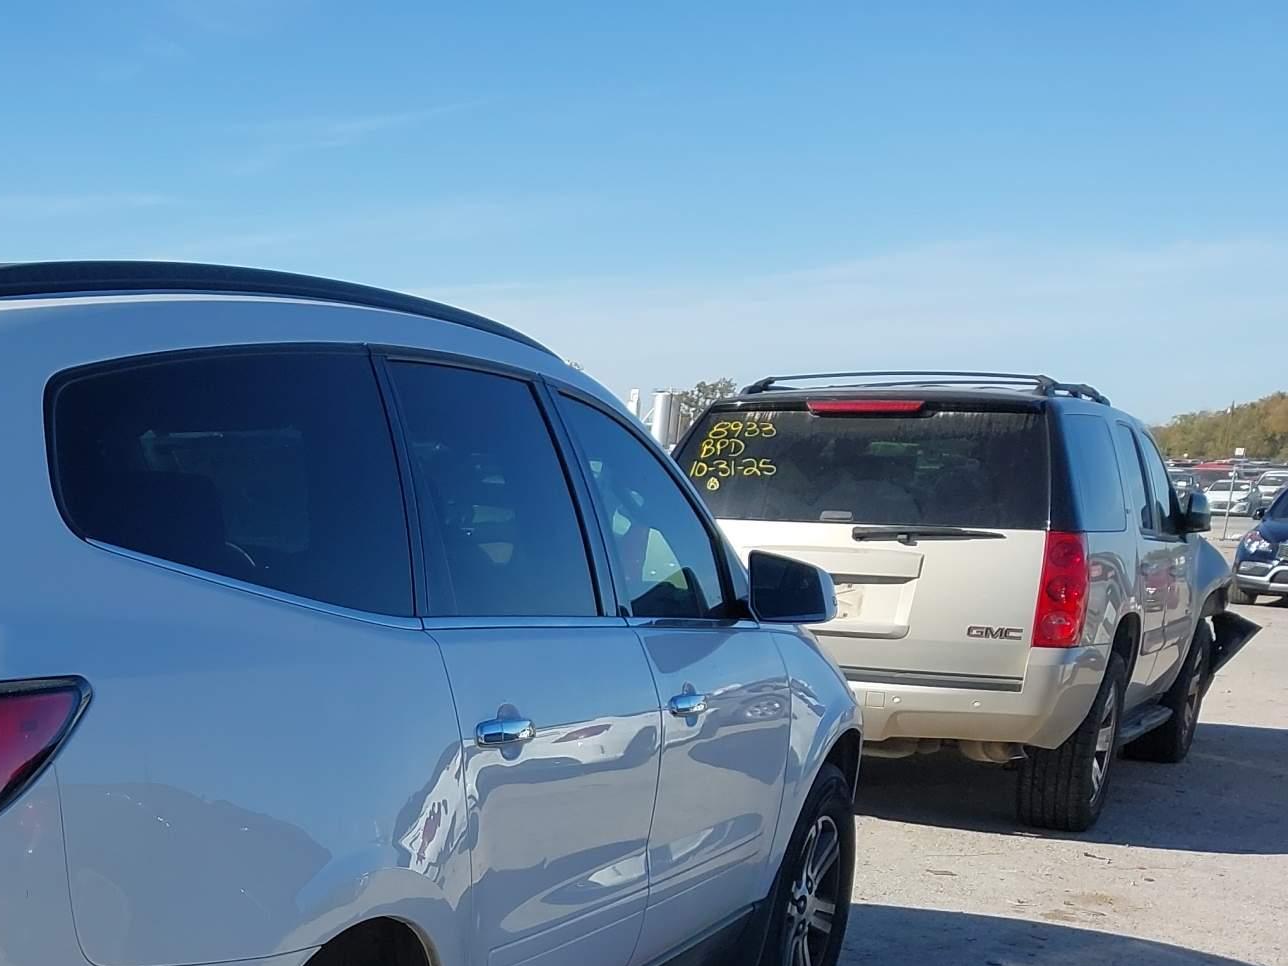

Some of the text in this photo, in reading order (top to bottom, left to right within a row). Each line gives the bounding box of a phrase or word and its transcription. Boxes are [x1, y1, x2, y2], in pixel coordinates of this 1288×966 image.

[708, 421, 777, 439] 8933
[700, 438, 745, 459] BPD
[689, 458, 777, 478] 10-31-25
[966, 624, 1025, 641] GMC
